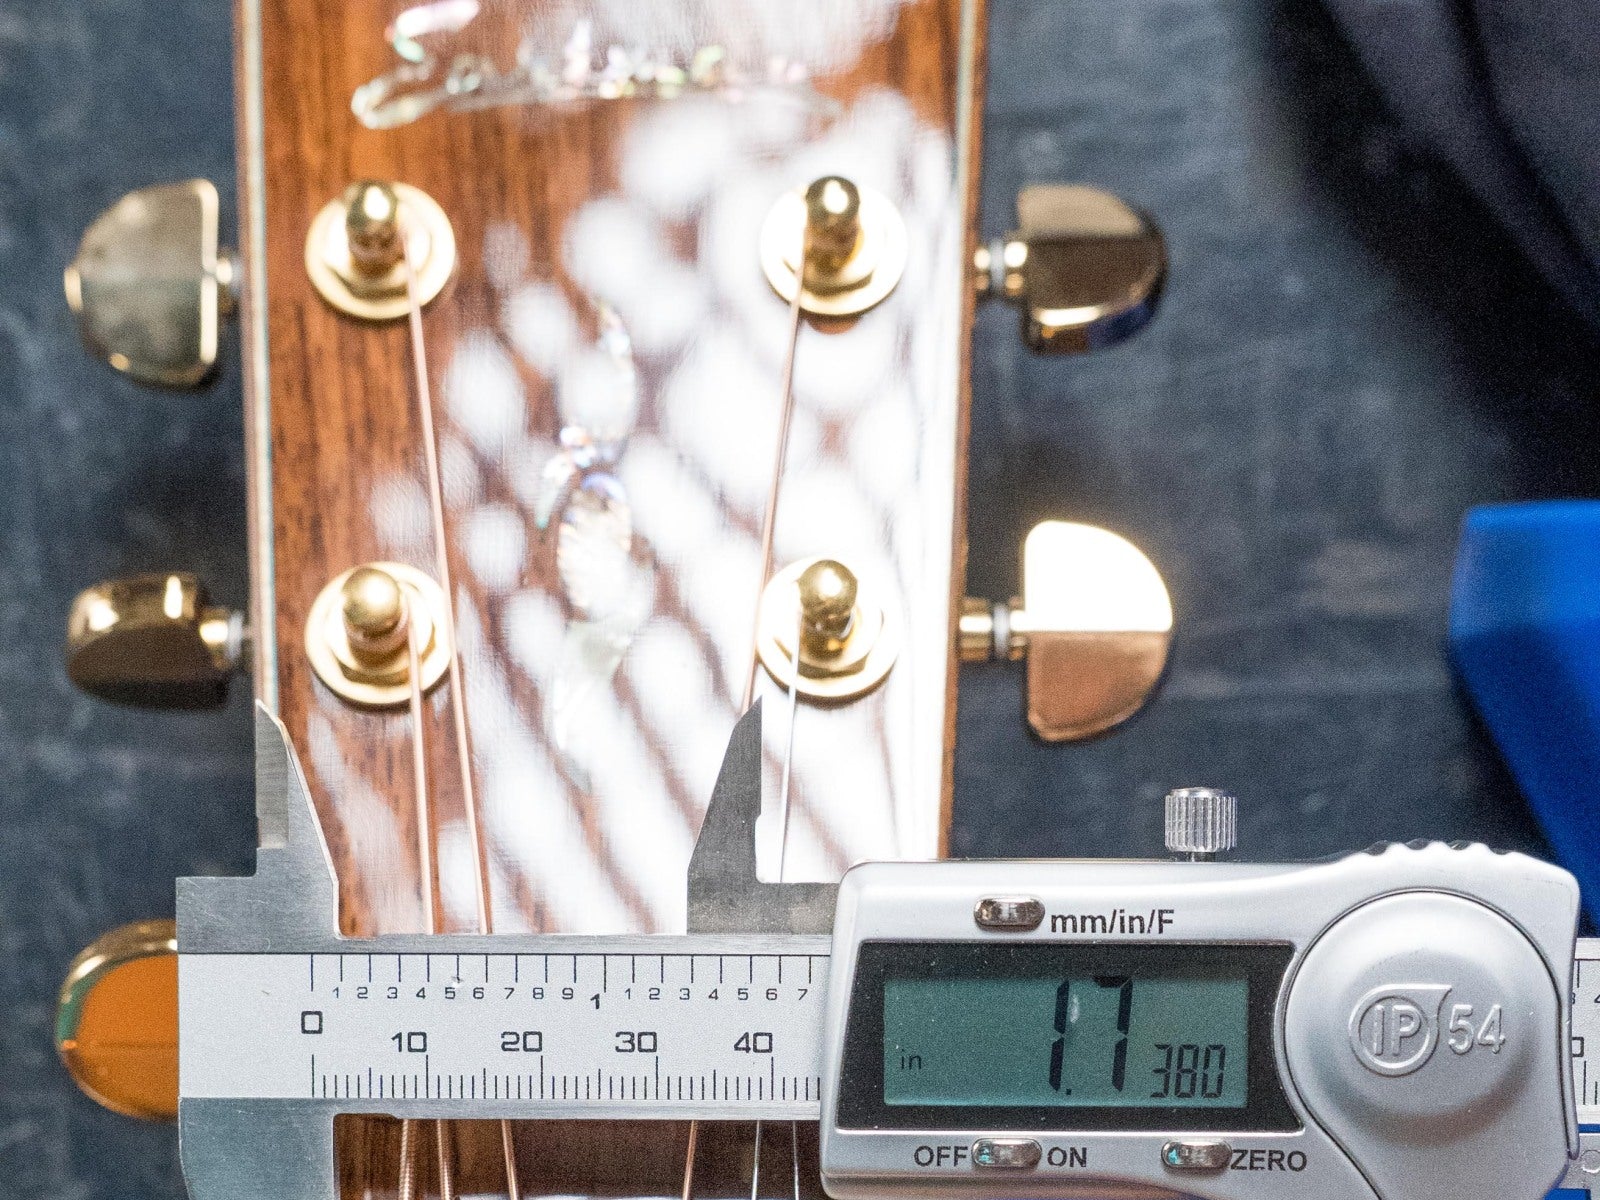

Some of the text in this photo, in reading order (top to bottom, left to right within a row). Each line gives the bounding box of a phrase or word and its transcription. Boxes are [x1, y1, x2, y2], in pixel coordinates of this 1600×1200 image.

[1050, 909, 1175, 935] mm/in/F
[357, 986, 369, 1000] 2
[387, 986, 398, 1000] 3
[415, 986, 426, 1000] 4
[444, 986, 456, 1000] 5
[472, 986, 484, 1000] 6
[503, 986, 515, 1000] 7
[532, 986, 544, 1000] 8
[561, 986, 574, 1000] 9
[590, 993, 600, 1010] 1
[648, 987, 661, 1001] 2
[679, 987, 690, 1001] 3
[708, 987, 719, 1001] 4
[737, 987, 749, 1001] 5
[765, 987, 778, 1001] 6
[797, 987, 808, 1001] 7
[301, 1010, 774, 1054] 0 10 20 30 40
[1371, 1003, 1506, 1057] IP 54
[900, 1048, 923, 1071] in
[914, 1145, 968, 1168] OFF
[1046, 1147, 1088, 1169] ON
[1230, 1148, 1308, 1173] ZERO
